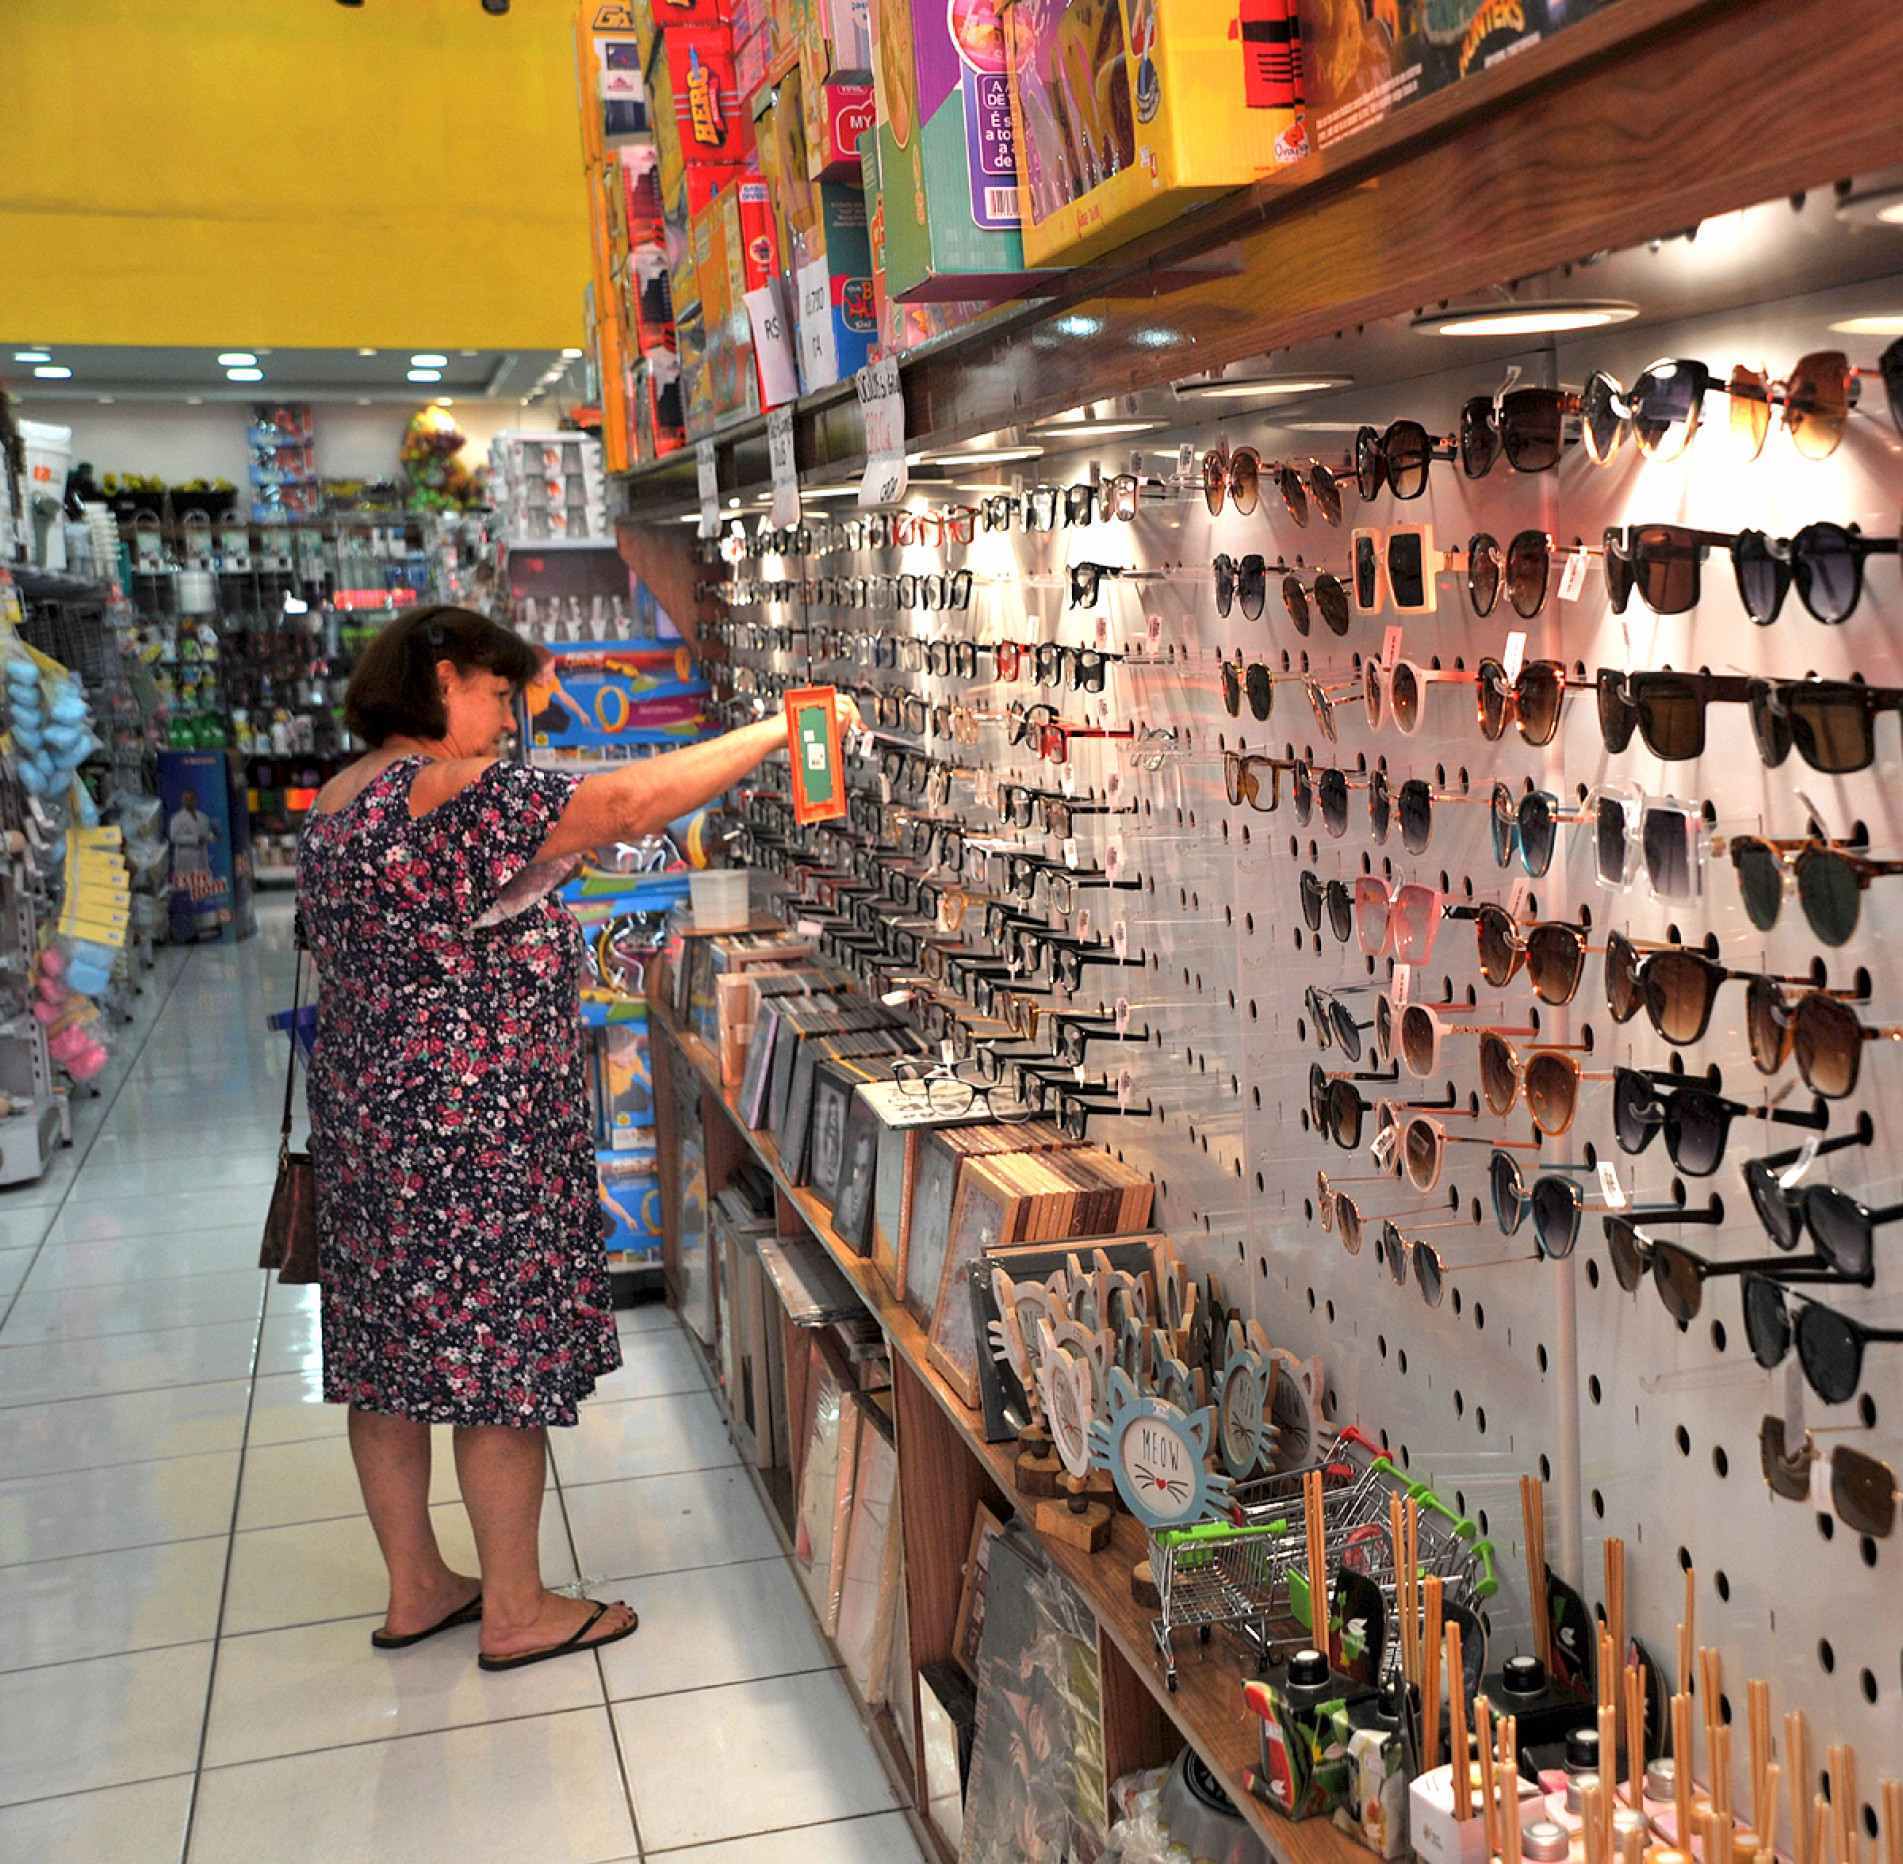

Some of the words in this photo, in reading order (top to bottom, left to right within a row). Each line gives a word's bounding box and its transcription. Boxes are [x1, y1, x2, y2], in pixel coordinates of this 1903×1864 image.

[987, 94, 1006, 106] DE
[850, 115, 872, 129] MY
[985, 129, 995, 141] a
[998, 142, 1008, 154] a
[1142, 1428, 1179, 1472] MEOW
